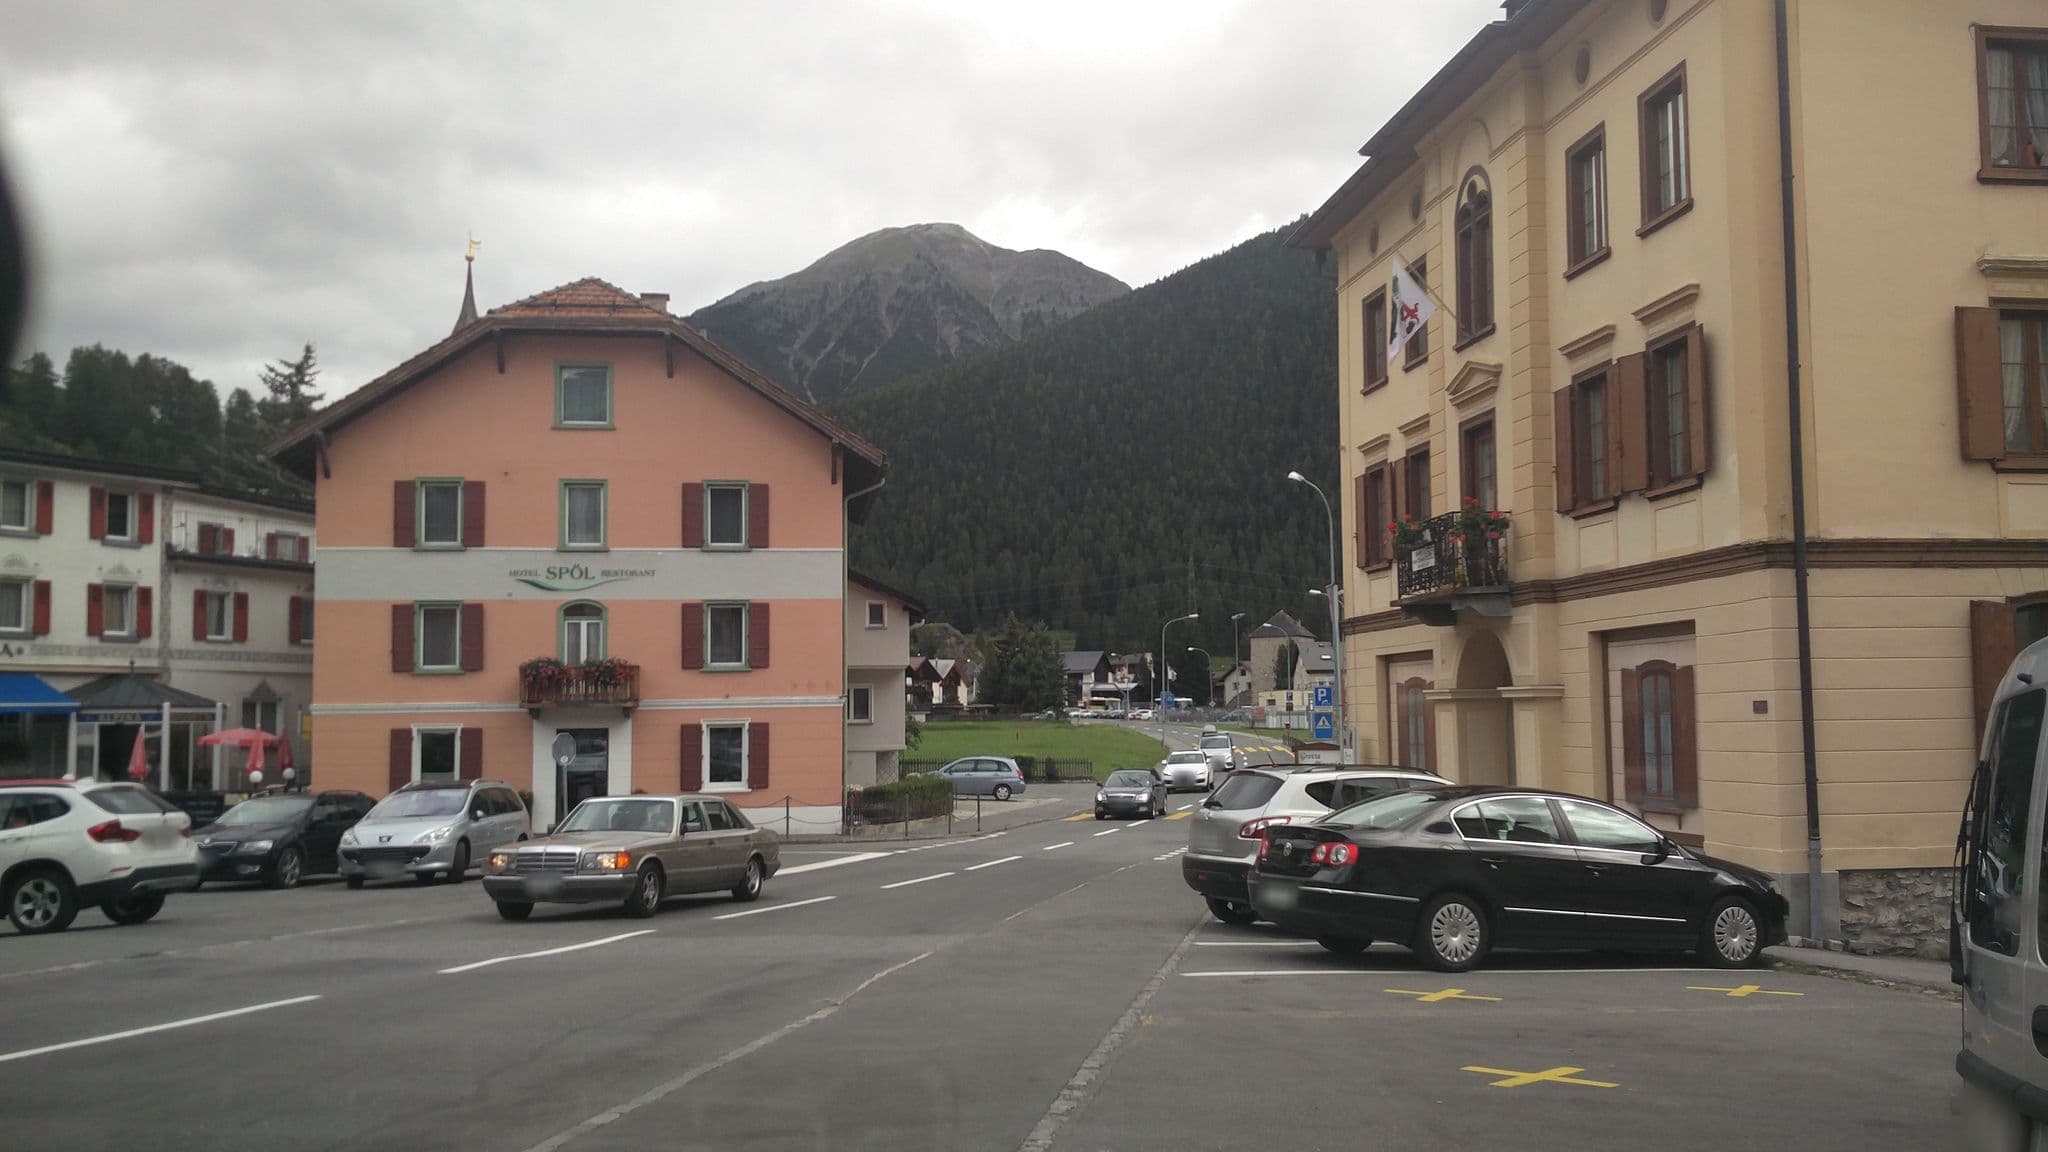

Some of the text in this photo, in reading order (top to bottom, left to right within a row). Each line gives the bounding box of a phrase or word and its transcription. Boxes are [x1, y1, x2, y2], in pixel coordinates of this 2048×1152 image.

[509, 563, 657, 580] HOTEL SPÖL RESTORANT
[1318, 688, 1326, 701] P
